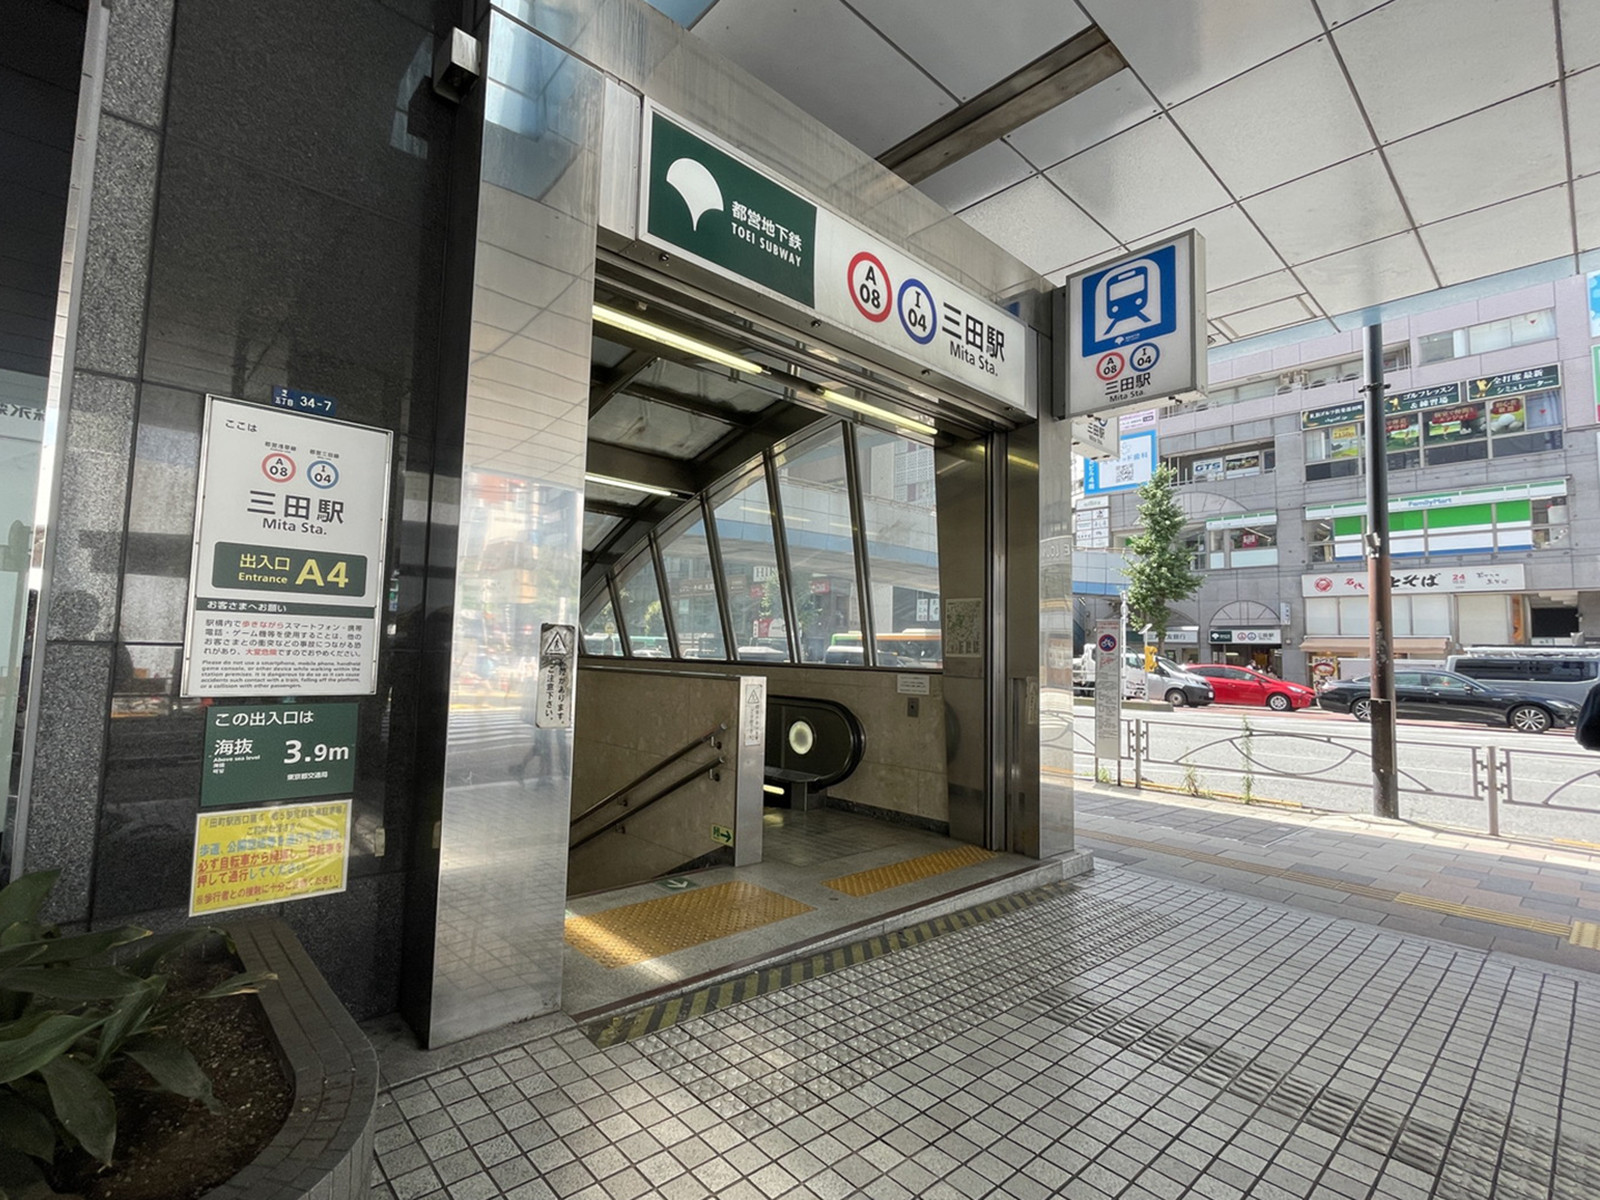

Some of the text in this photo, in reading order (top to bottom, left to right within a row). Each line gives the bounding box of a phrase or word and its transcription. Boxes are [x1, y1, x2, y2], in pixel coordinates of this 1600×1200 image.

[732, 201, 802, 252] 都営地下鉄
[731, 222, 802, 267] TOEI SUBWAY
[865, 266, 876, 286] A
[860, 284, 881, 310] 08
[914, 290, 921, 308] I
[908, 308, 927, 332] 04
[942, 302, 1005, 362] 三田駅
[950, 340, 998, 376] Mita Sta.
[1142, 348, 1147, 356] I
[1106, 357, 1114, 366] A
[1137, 356, 1152, 366] 04
[1103, 364, 1118, 376] 08
[1105, 372, 1151, 396] 三田駅
[1496, 380, 1554, 394] シミュレーター
[1109, 392, 1128, 403] Mita
[1403, 386, 1454, 400] ゴルフレッスン
[300, 396, 332, 410] 34-7
[225, 420, 258, 432] ここは
[276, 458, 284, 466] A
[1195, 462, 1221, 472] GTS
[270, 466, 288, 478] 08
[314, 472, 332, 484] 04
[247, 490, 344, 524] 三田駅
[1408, 498, 1452, 507] FamilyMart
[262, 518, 328, 536] Mita Sta.
[240, 553, 290, 571] 出入口
[238, 572, 288, 584] Entrance
[295, 558, 349, 588] A4
[207, 600, 286, 612] お客さまへお願い
[215, 710, 314, 727] この出入口は
[214, 738, 253, 756] 海抜
[284, 740, 349, 764] 3.9m
